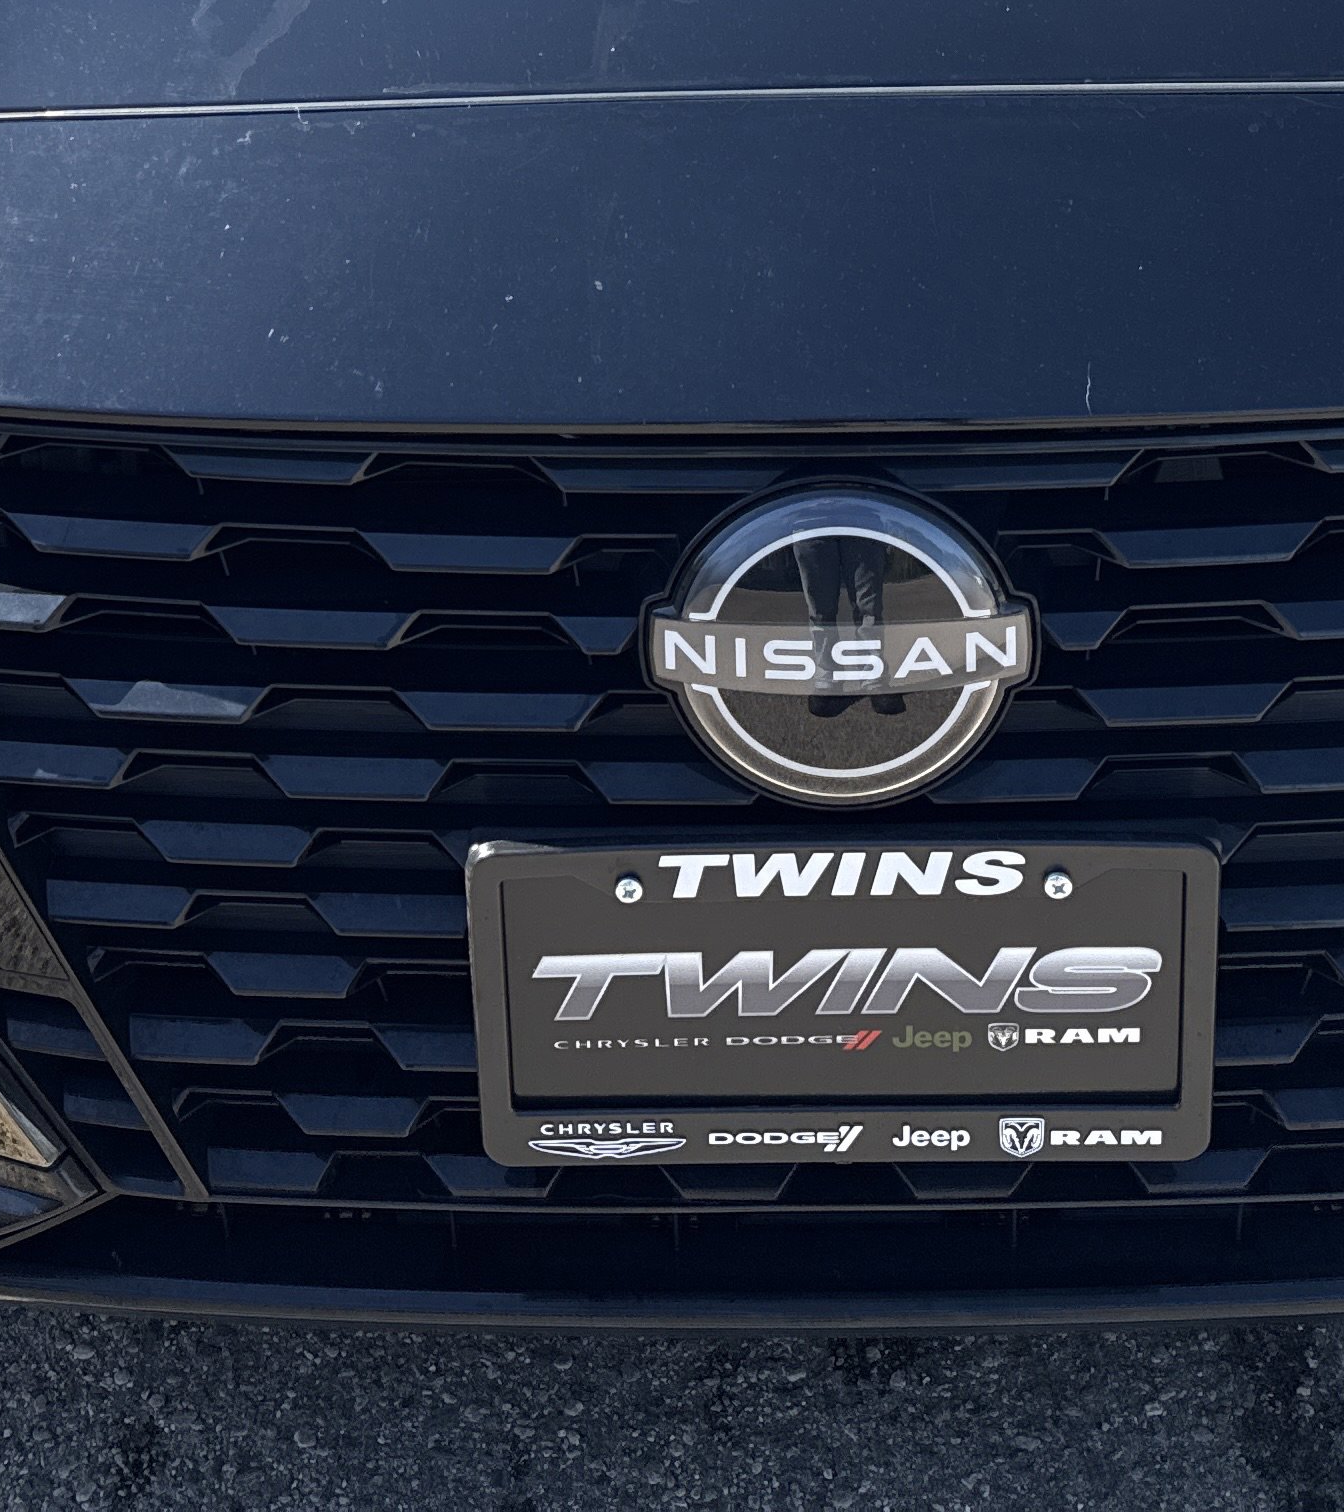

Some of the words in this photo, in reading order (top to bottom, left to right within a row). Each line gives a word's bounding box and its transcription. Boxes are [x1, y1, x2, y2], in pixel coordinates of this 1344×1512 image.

[664, 626, 1016, 681] NISSAN
[658, 850, 1026, 898] TWINS
[532, 947, 1162, 1021] TWINS
[554, 1038, 709, 1049] CHRYSLER
[726, 1035, 858, 1046] DODGE
[892, 1025, 972, 1052] Jeep
[1024, 1027, 1141, 1044] RAM
[540, 1122, 674, 1136] CHRYSLER
[708, 1131, 841, 1145] DODGE
[892, 1125, 971, 1151] Jeep
[1050, 1130, 1163, 1145] RAM
